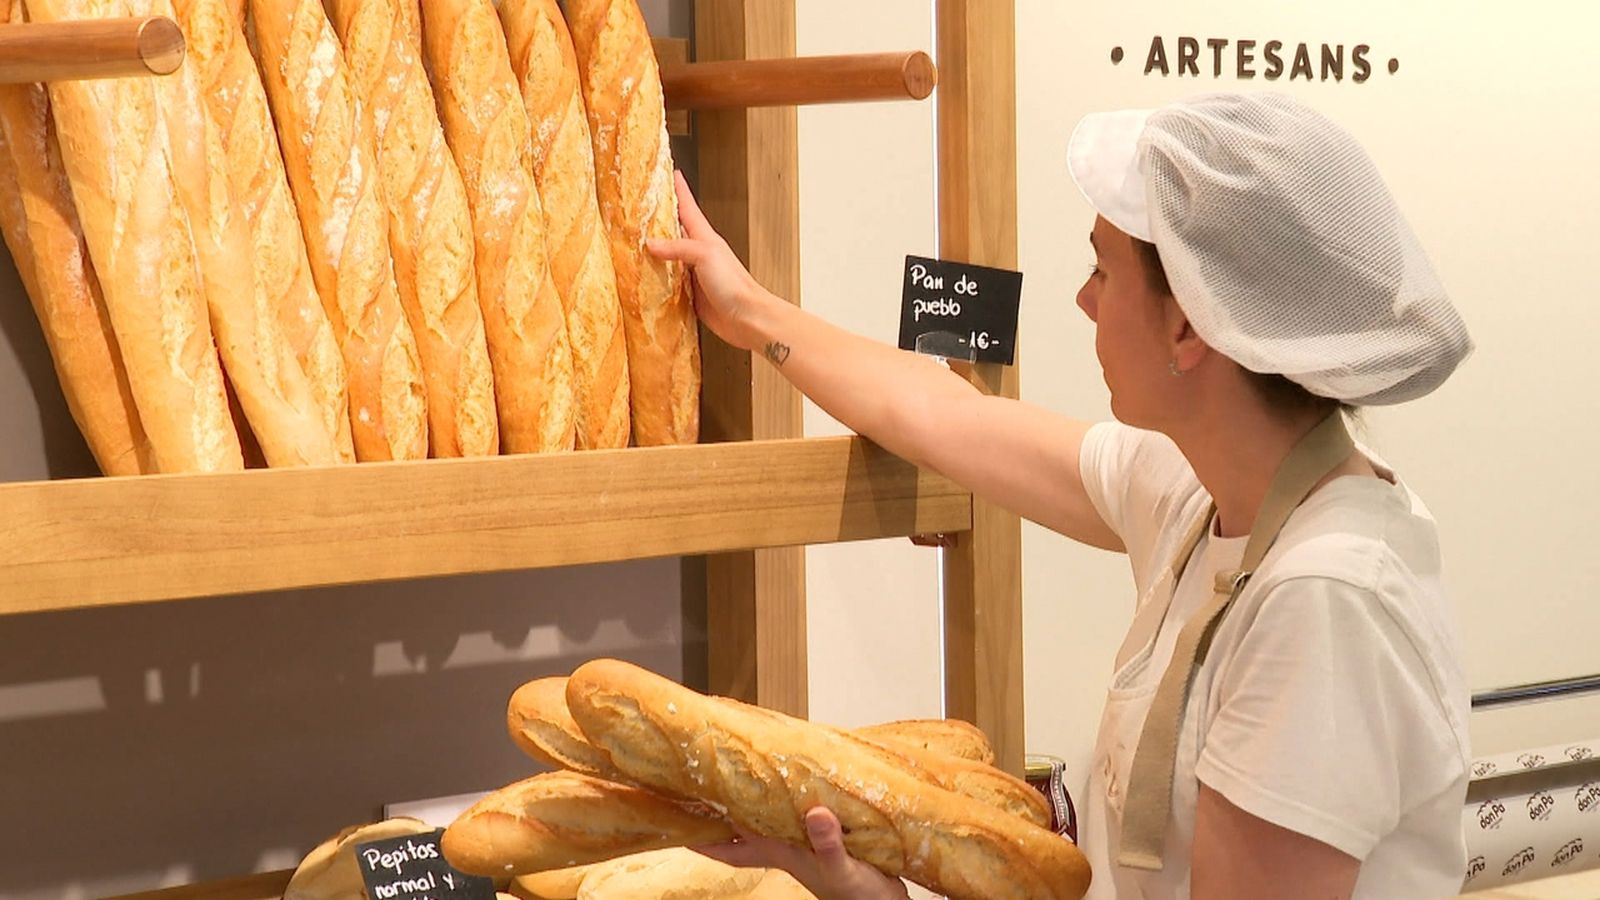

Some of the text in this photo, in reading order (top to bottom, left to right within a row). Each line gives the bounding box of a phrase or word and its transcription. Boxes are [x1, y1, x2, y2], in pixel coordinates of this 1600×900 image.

[1144, 36, 1372, 83] ARTESANS
[910, 264, 979, 296] Pan de
[362, 839, 440, 875] Pepitos
[374, 870, 455, 899] normal y
